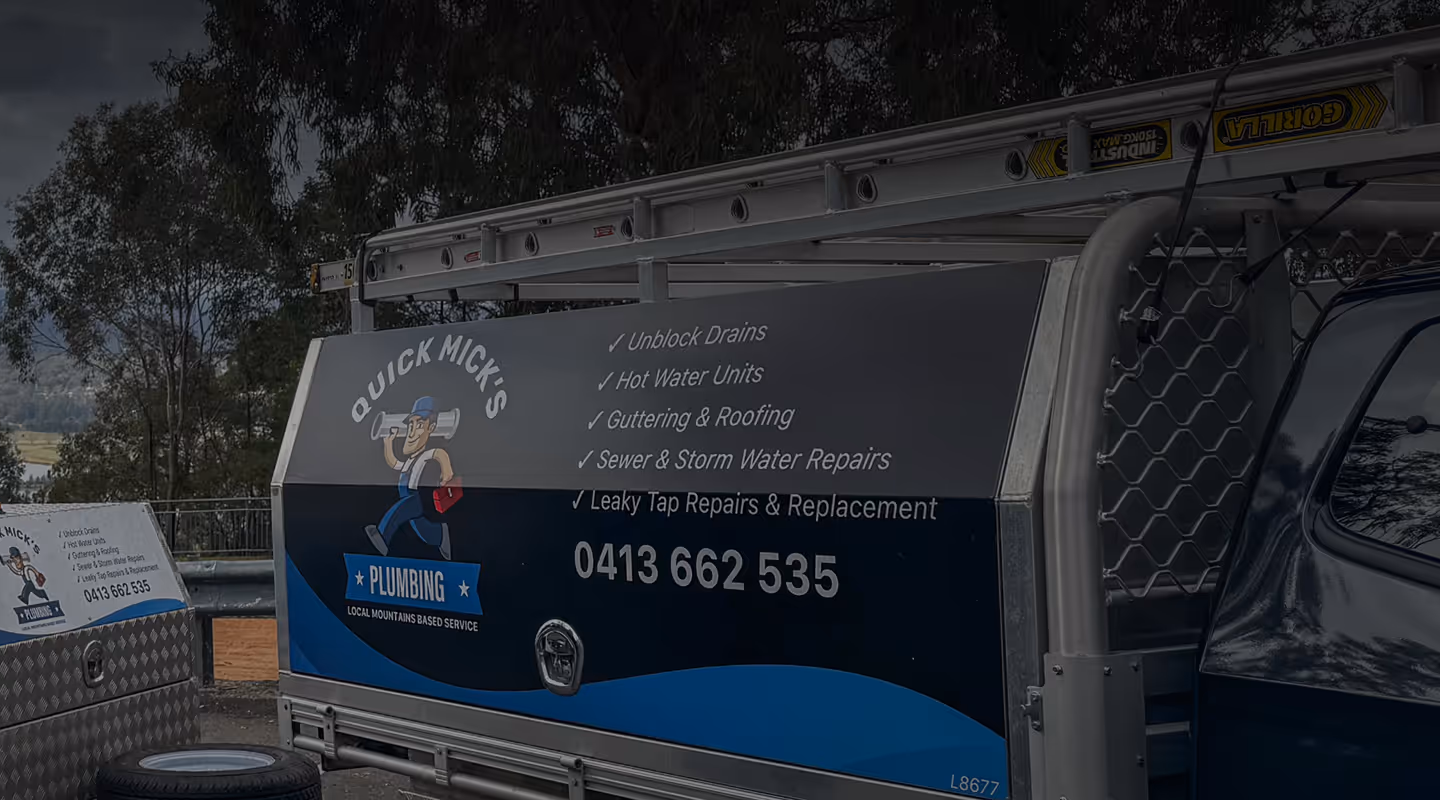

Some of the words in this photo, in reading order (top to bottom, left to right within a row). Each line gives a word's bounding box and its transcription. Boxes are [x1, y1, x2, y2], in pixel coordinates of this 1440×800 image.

[1224, 100, 1346, 142] GORILLA
[628, 326, 703, 351] Unblock
[704, 322, 768, 345] Drains
[351, 336, 435, 423] QUICK
[438, 334, 508, 419] MICK'S
[616, 370, 650, 390] Hot
[654, 368, 709, 388] Water
[713, 362, 765, 385] Units
[607, 407, 692, 433] Guttering
[695, 407, 711, 427] &
[715, 404, 795, 431] Roofing
[596, 449, 653, 470] Sewer
[655, 449, 670, 470] &
[675, 448, 734, 470] Storm
[740, 448, 803, 470] Water
[806, 446, 892, 475] Repairs
[591, 490, 642, 516] Leaky
[647, 491, 680, 517] Tap
[685, 491, 760, 518] Repairs
[765, 493, 780, 516] &
[788, 493, 938, 522] Replacement
[4, 526, 41, 555] MICK'S
[72, 550, 96, 559] Guttering
[97, 572, 107, 580] Tap
[369, 565, 445, 602] PLUMBING
[574, 540, 659, 584] 0413
[670, 546, 745, 591] 662
[758, 552, 840, 599] 535
[83, 586, 110, 602] 0413
[110, 583, 131, 598] 662
[131, 579, 151, 594] 535
[347, 605, 370, 618] LOCAL
[371, 608, 416, 624] MOUNTAINS
[417, 614, 442, 627] BASED
[444, 618, 479, 632] SERVICE
[950, 774, 1000, 796] L8677
